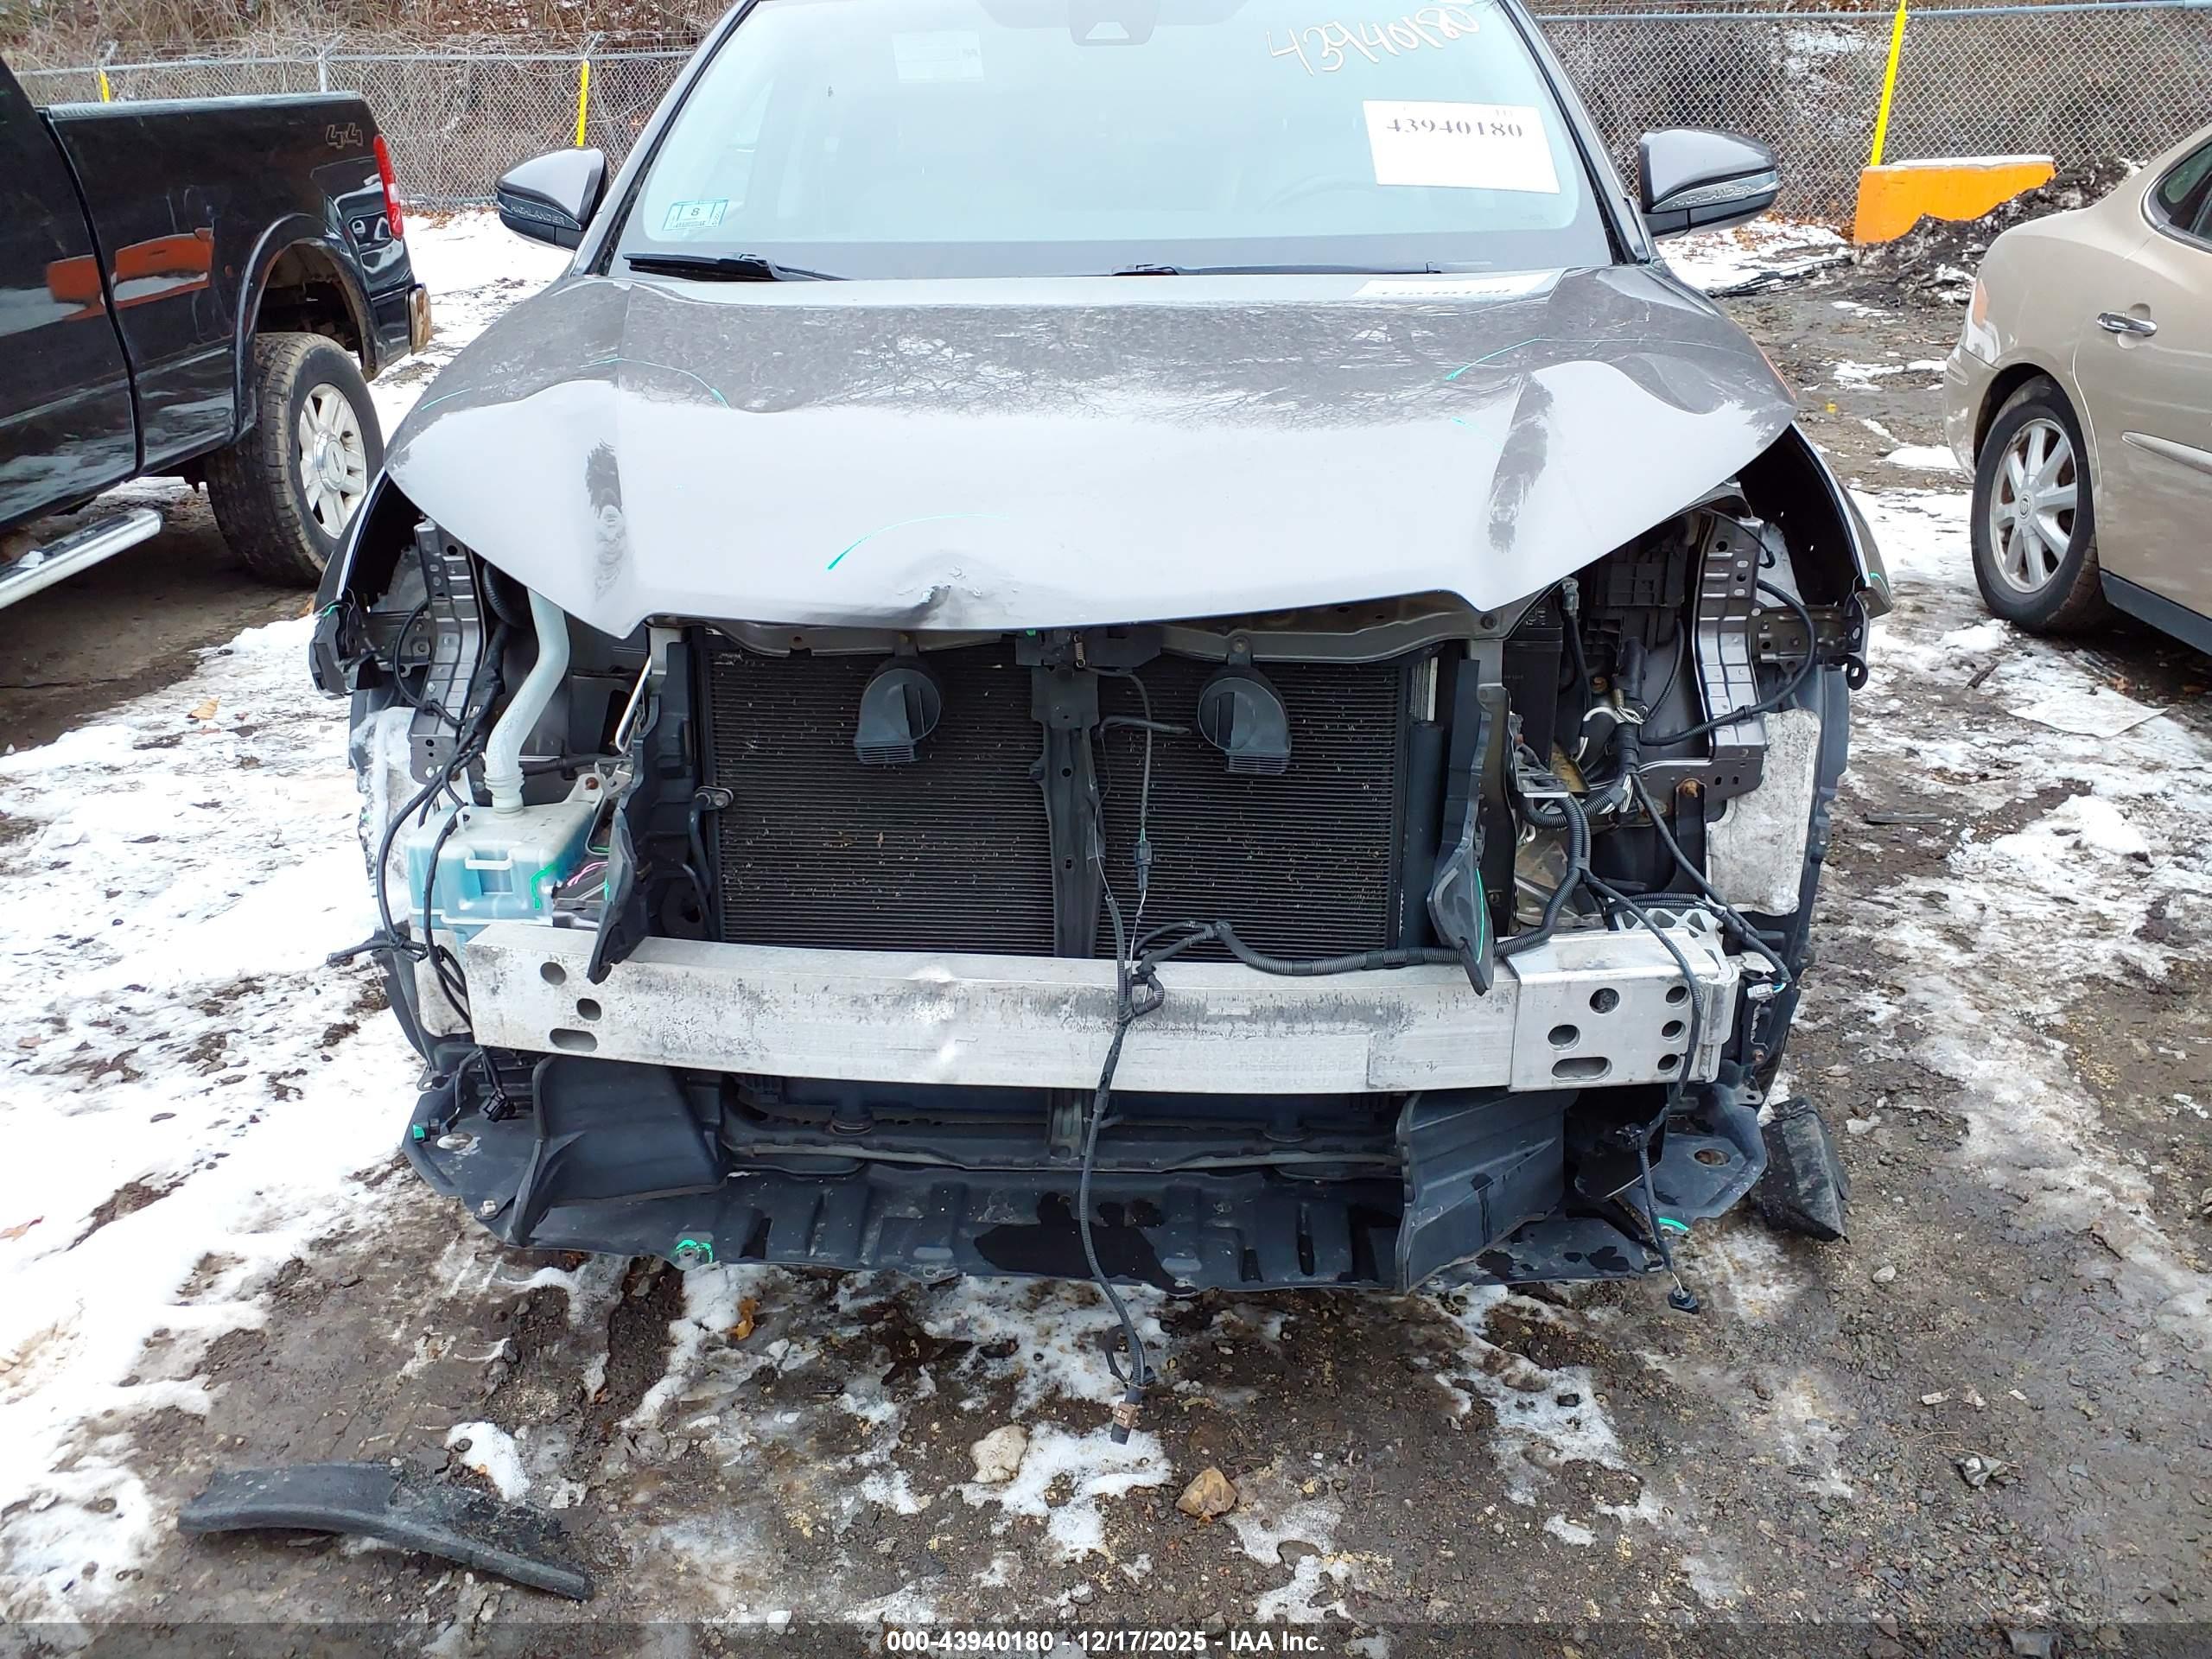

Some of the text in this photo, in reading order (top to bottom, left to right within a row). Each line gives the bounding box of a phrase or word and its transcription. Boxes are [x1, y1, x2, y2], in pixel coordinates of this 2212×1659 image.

[1266, 6, 1480, 76] 43940180
[1387, 118, 1522, 137] 43940180
[510, 204, 566, 226] HIGHLANDER
